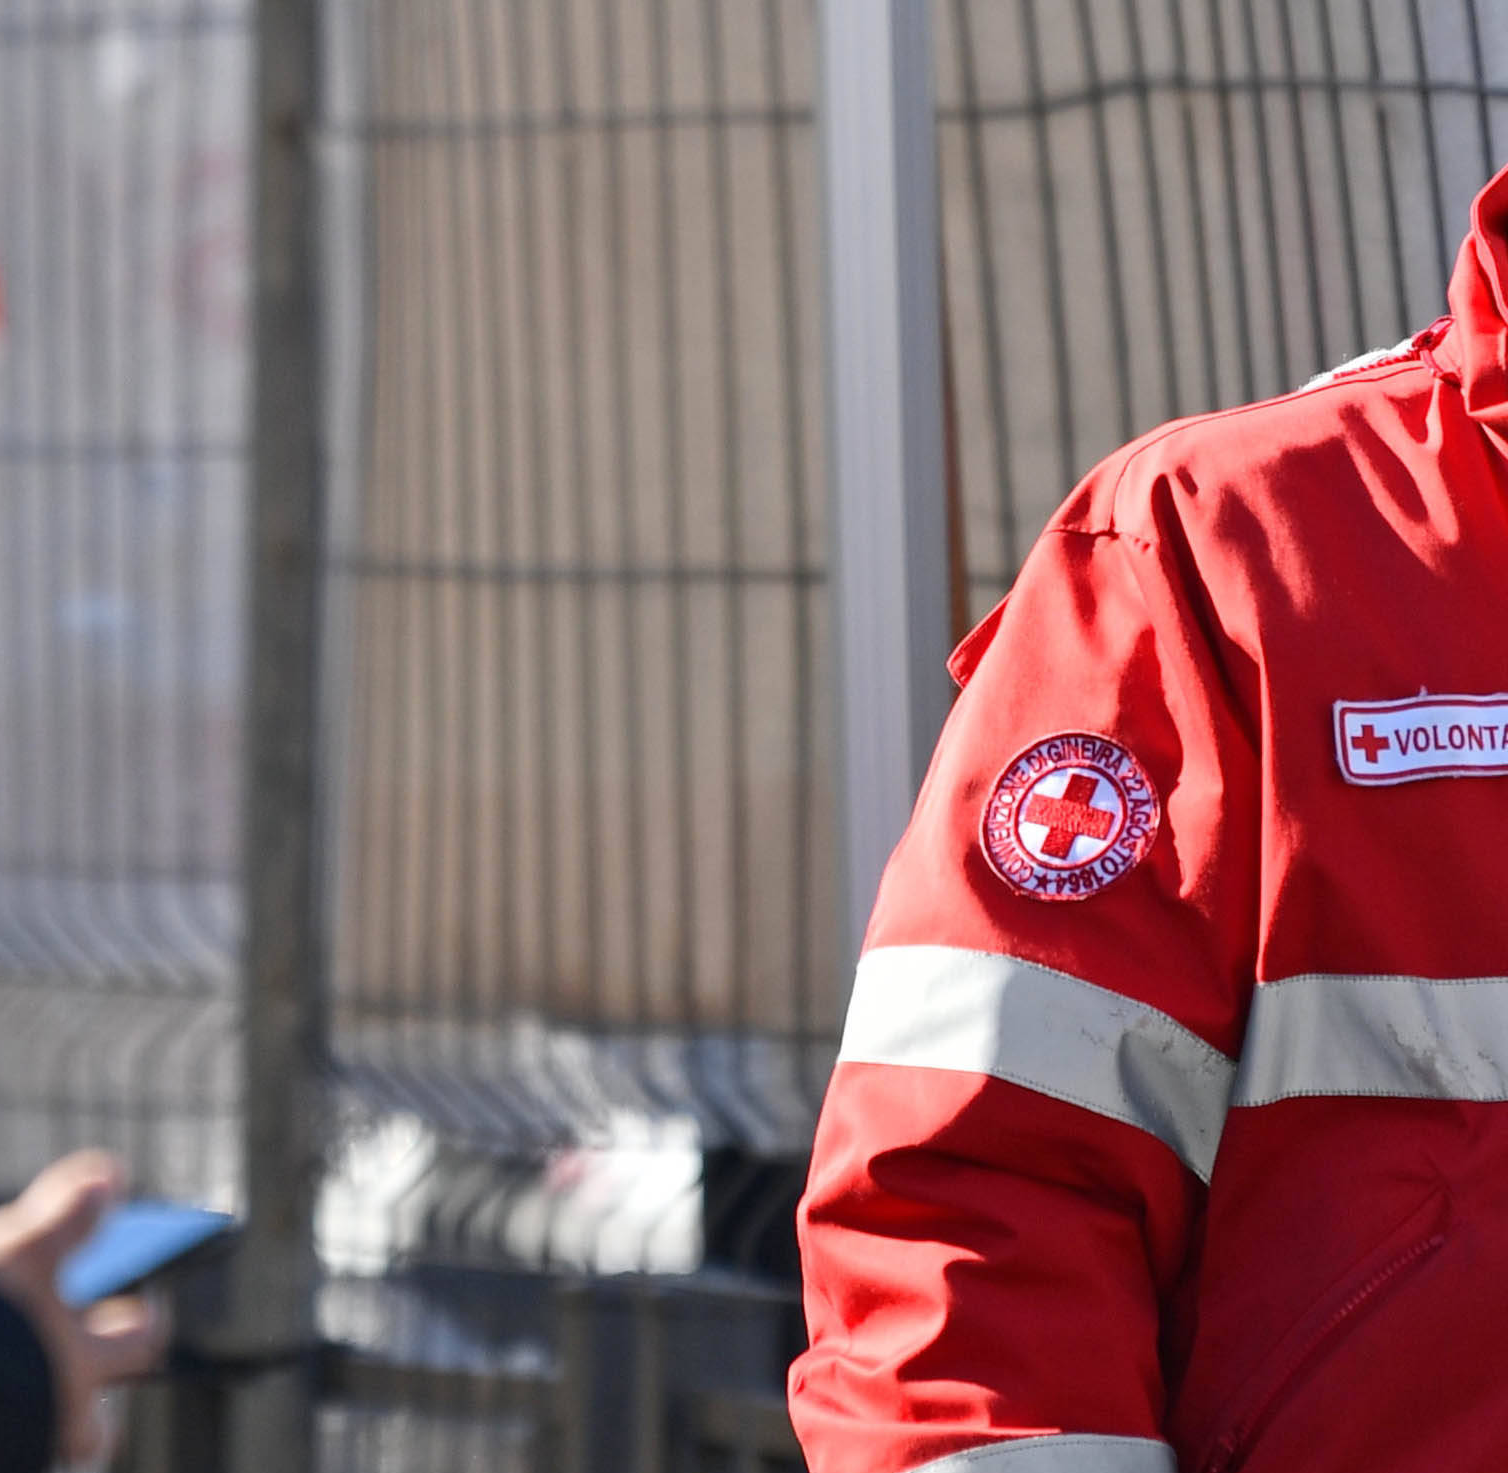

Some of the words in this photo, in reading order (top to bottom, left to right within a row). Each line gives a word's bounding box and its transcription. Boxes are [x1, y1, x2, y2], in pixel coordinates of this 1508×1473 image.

[1025, 753, 1050, 773] DI
[1046, 738, 1124, 775] GINEVRA
[1120, 765, 1144, 796] 22
[988, 766, 1034, 884] CONVENZIONE
[1100, 797, 1152, 876] AGOSTO
[1055, 865, 1104, 893] 1864
